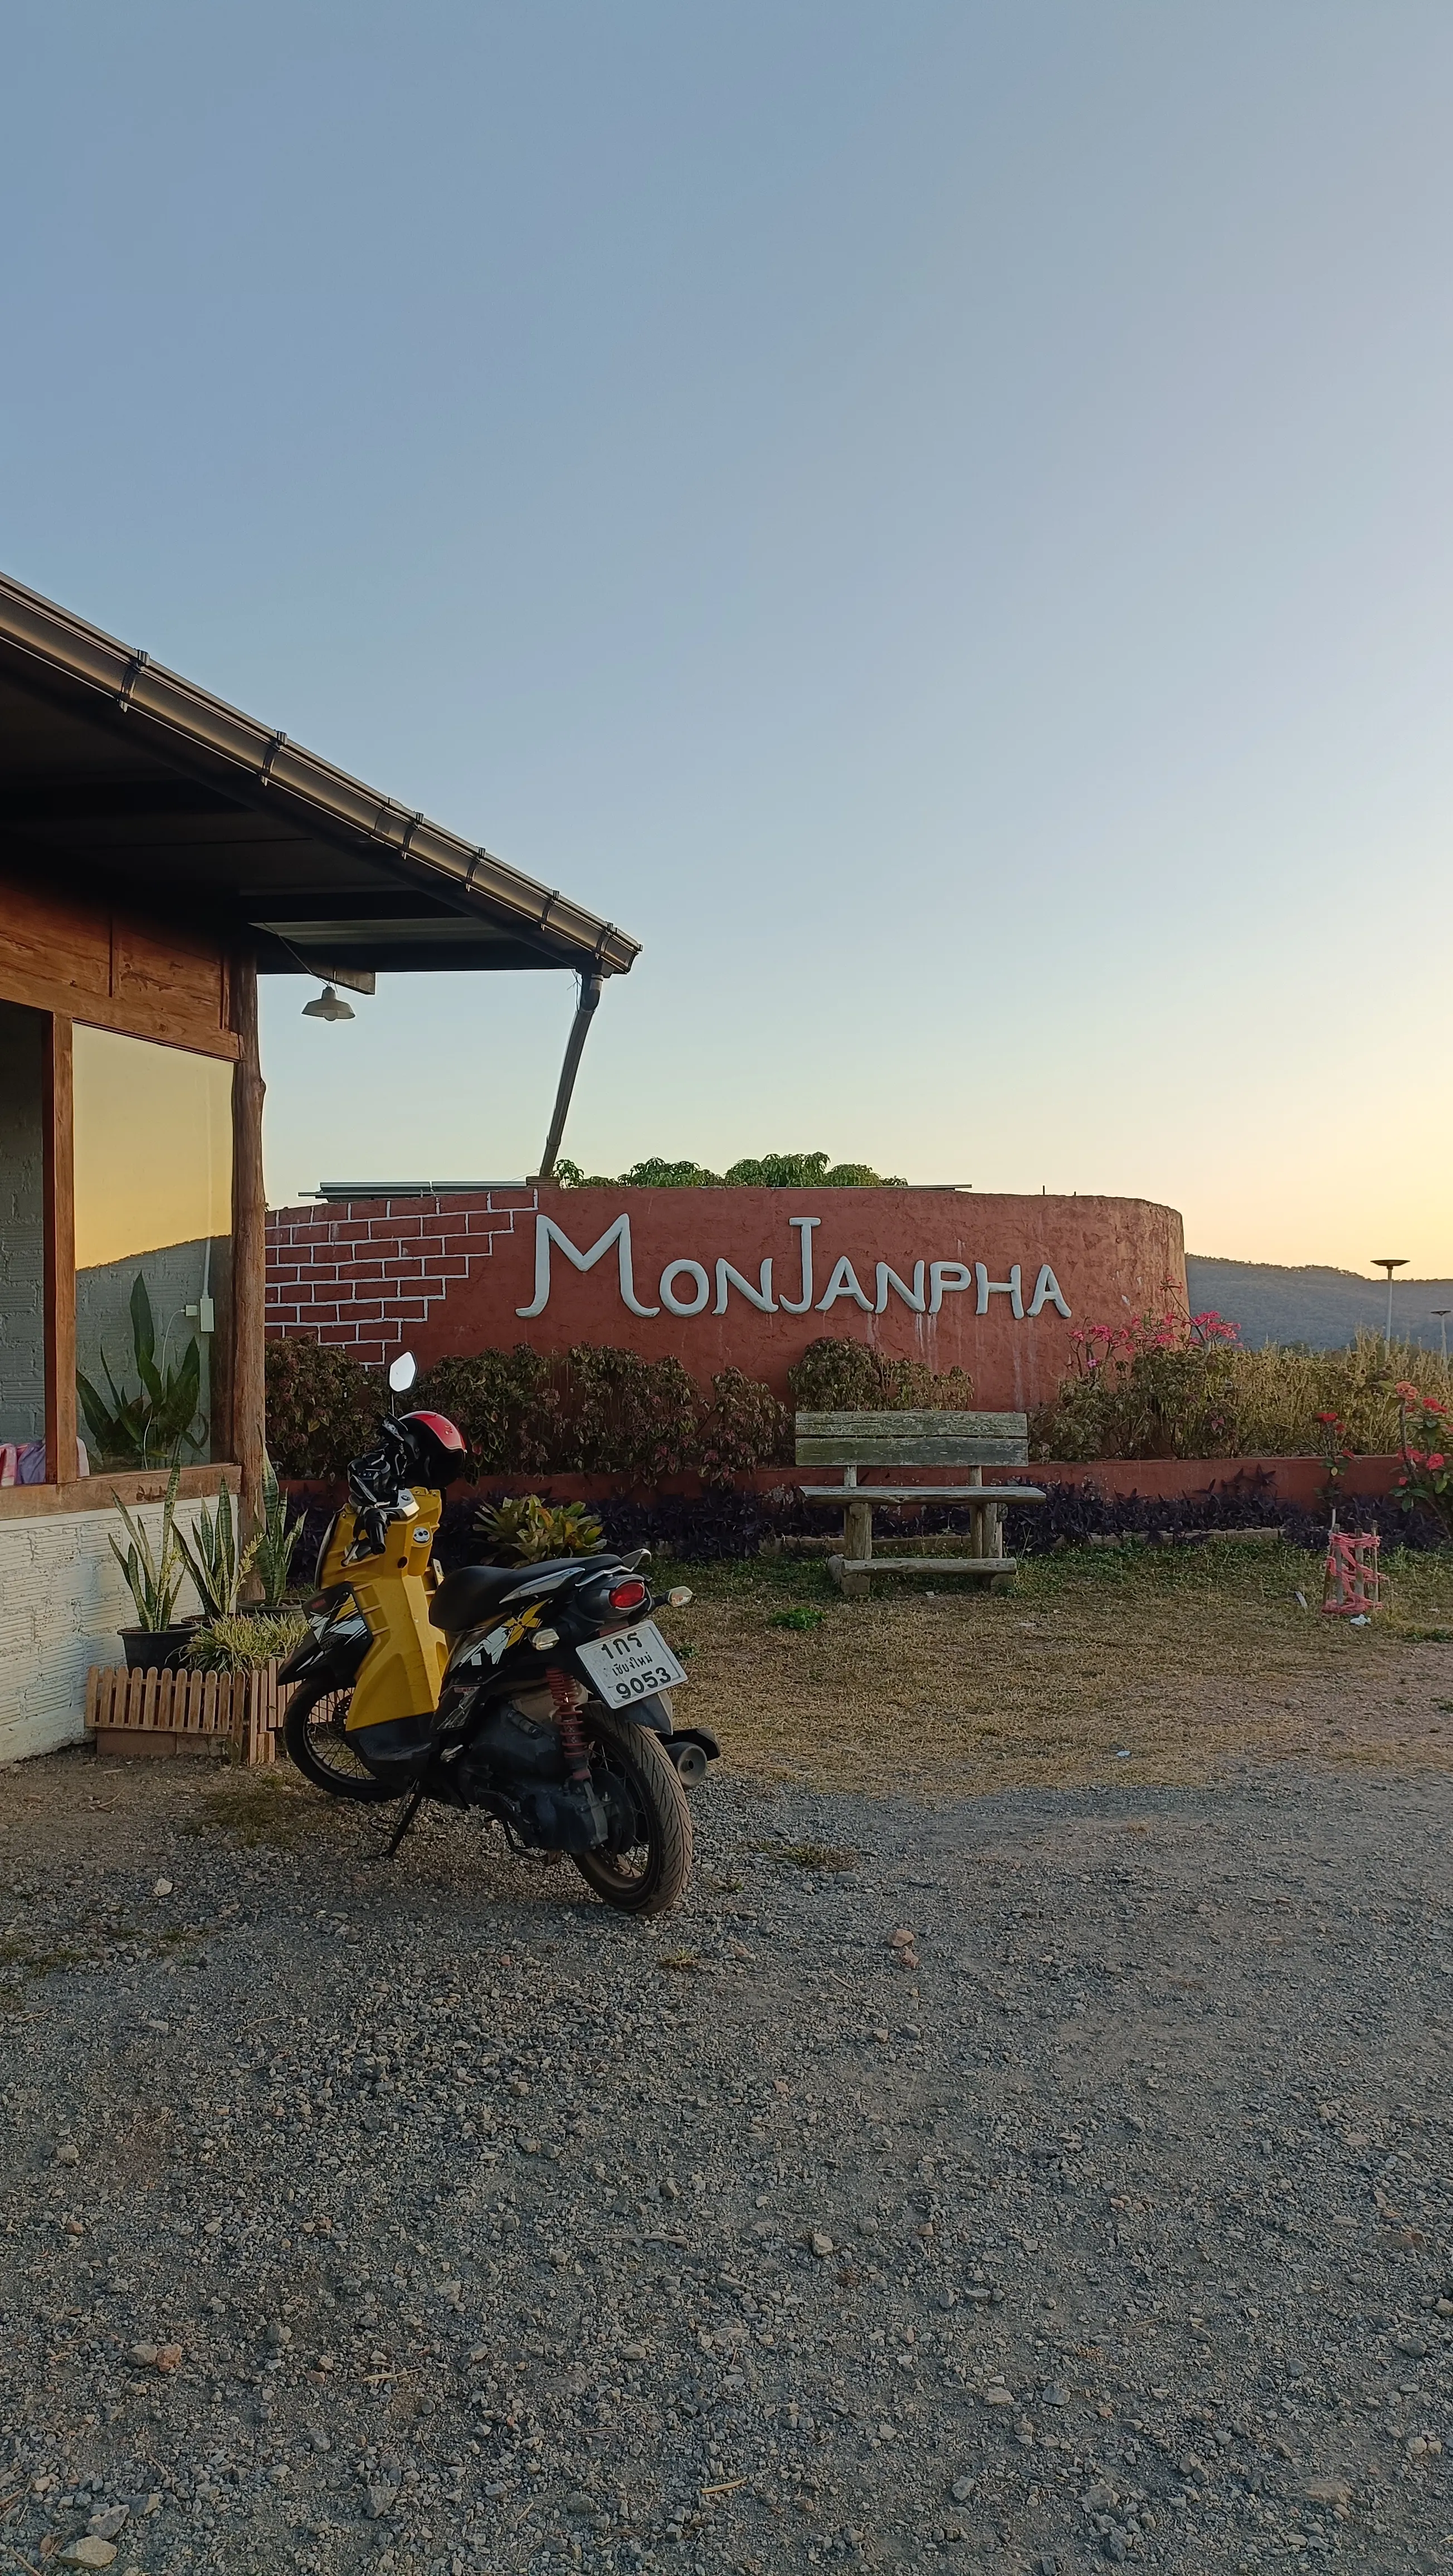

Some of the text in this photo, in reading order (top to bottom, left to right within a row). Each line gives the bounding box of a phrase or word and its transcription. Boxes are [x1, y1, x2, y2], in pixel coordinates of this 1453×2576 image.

[612, 1652, 652, 1676] เชียงใหม่
[616, 1667, 671, 1699] 9053
